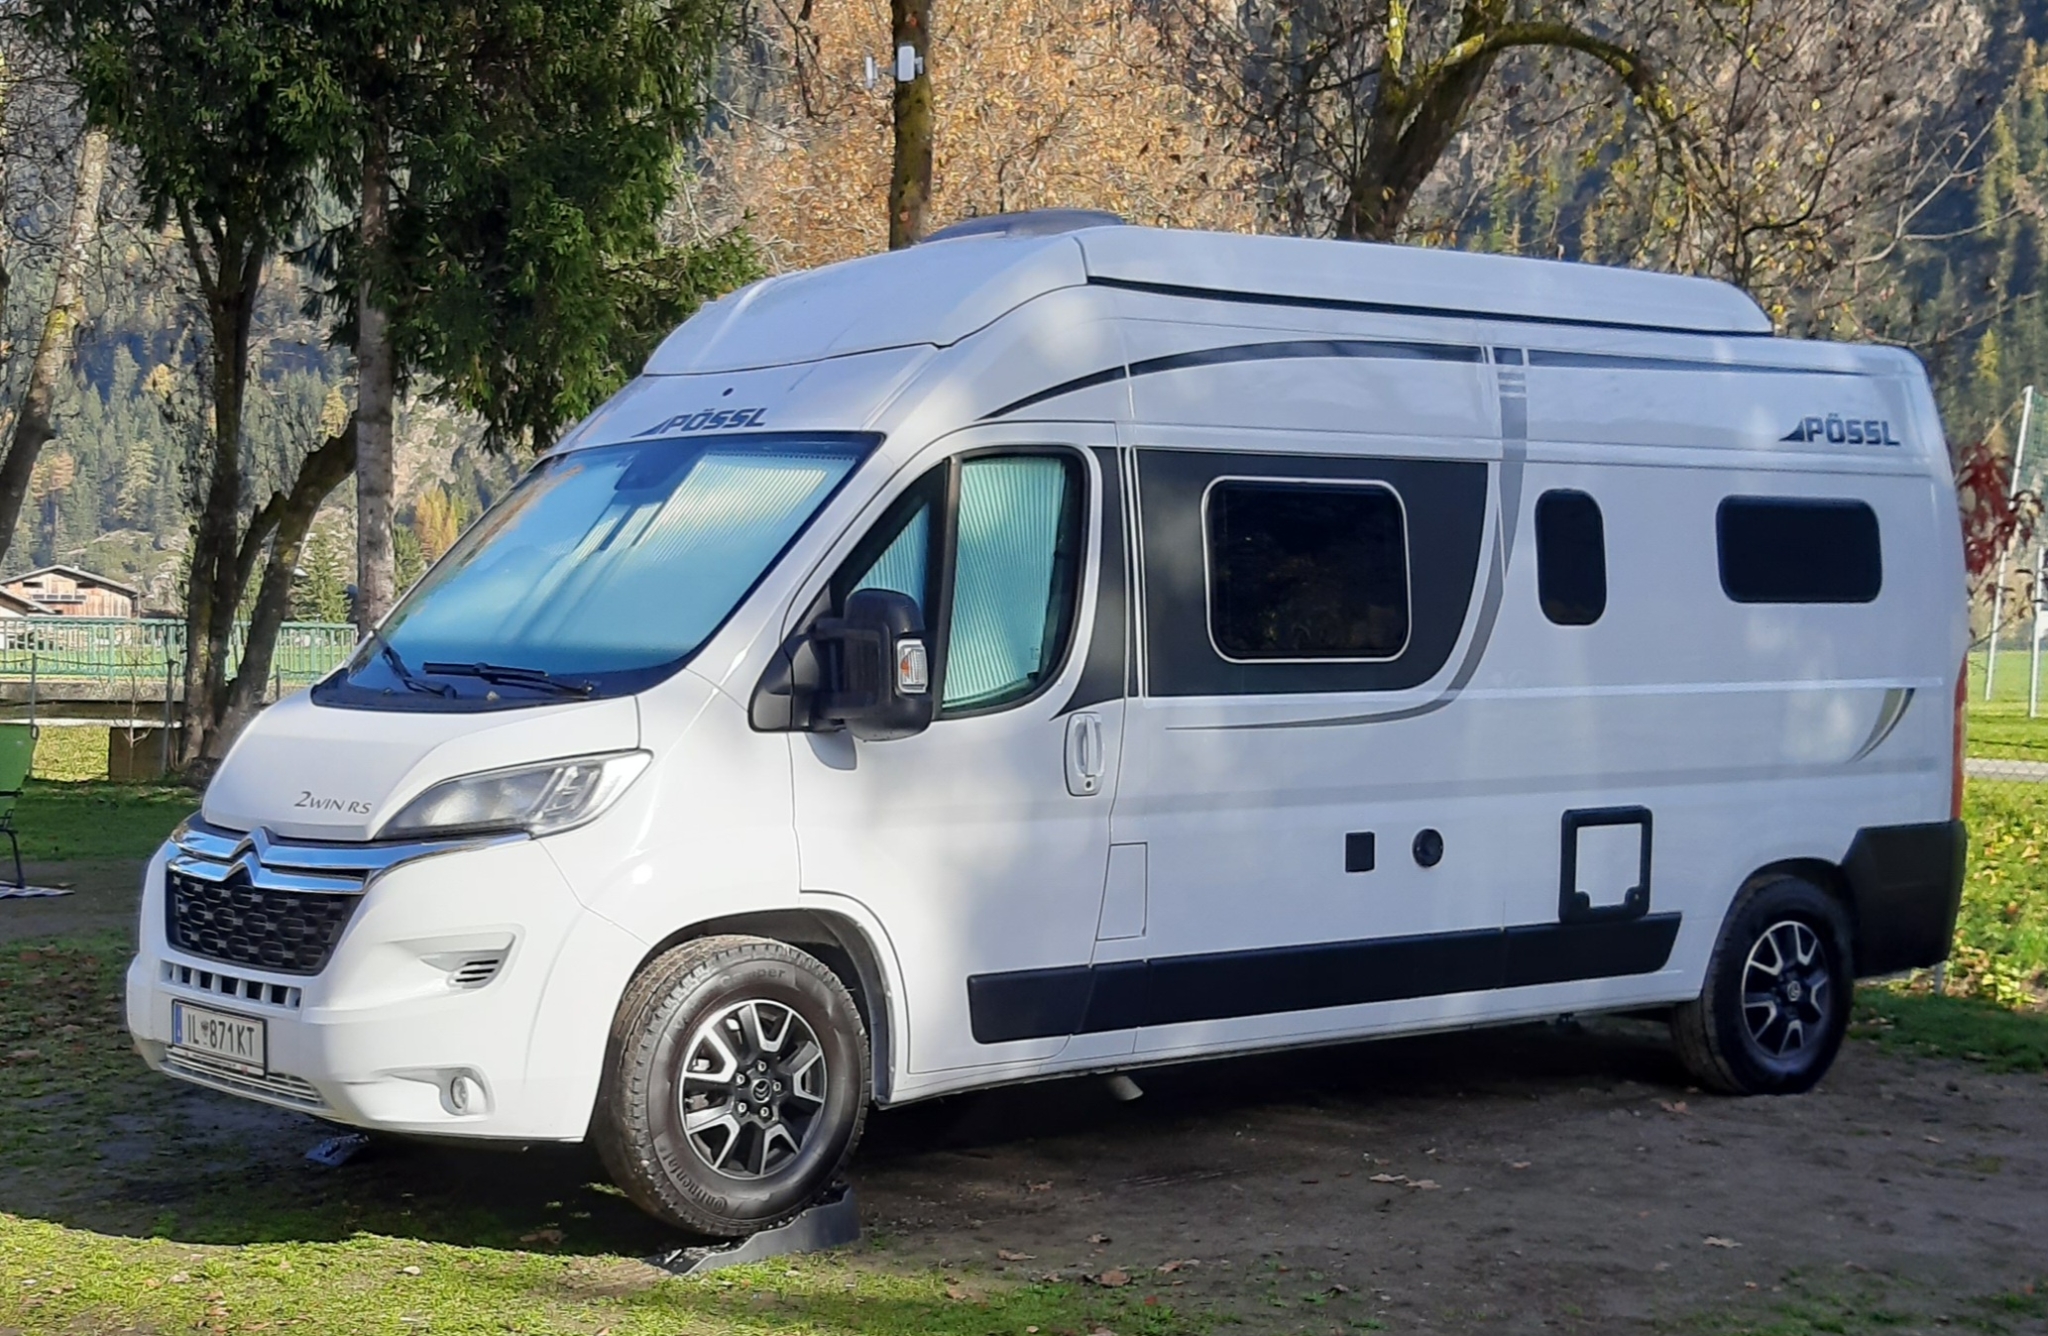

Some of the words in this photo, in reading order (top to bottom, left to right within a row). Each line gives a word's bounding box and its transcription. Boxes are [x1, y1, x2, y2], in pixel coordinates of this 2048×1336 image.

[658, 407, 768, 435] PÖSSL
[1804, 412, 1901, 446] PÖSSL
[347, 801, 373, 815] RS
